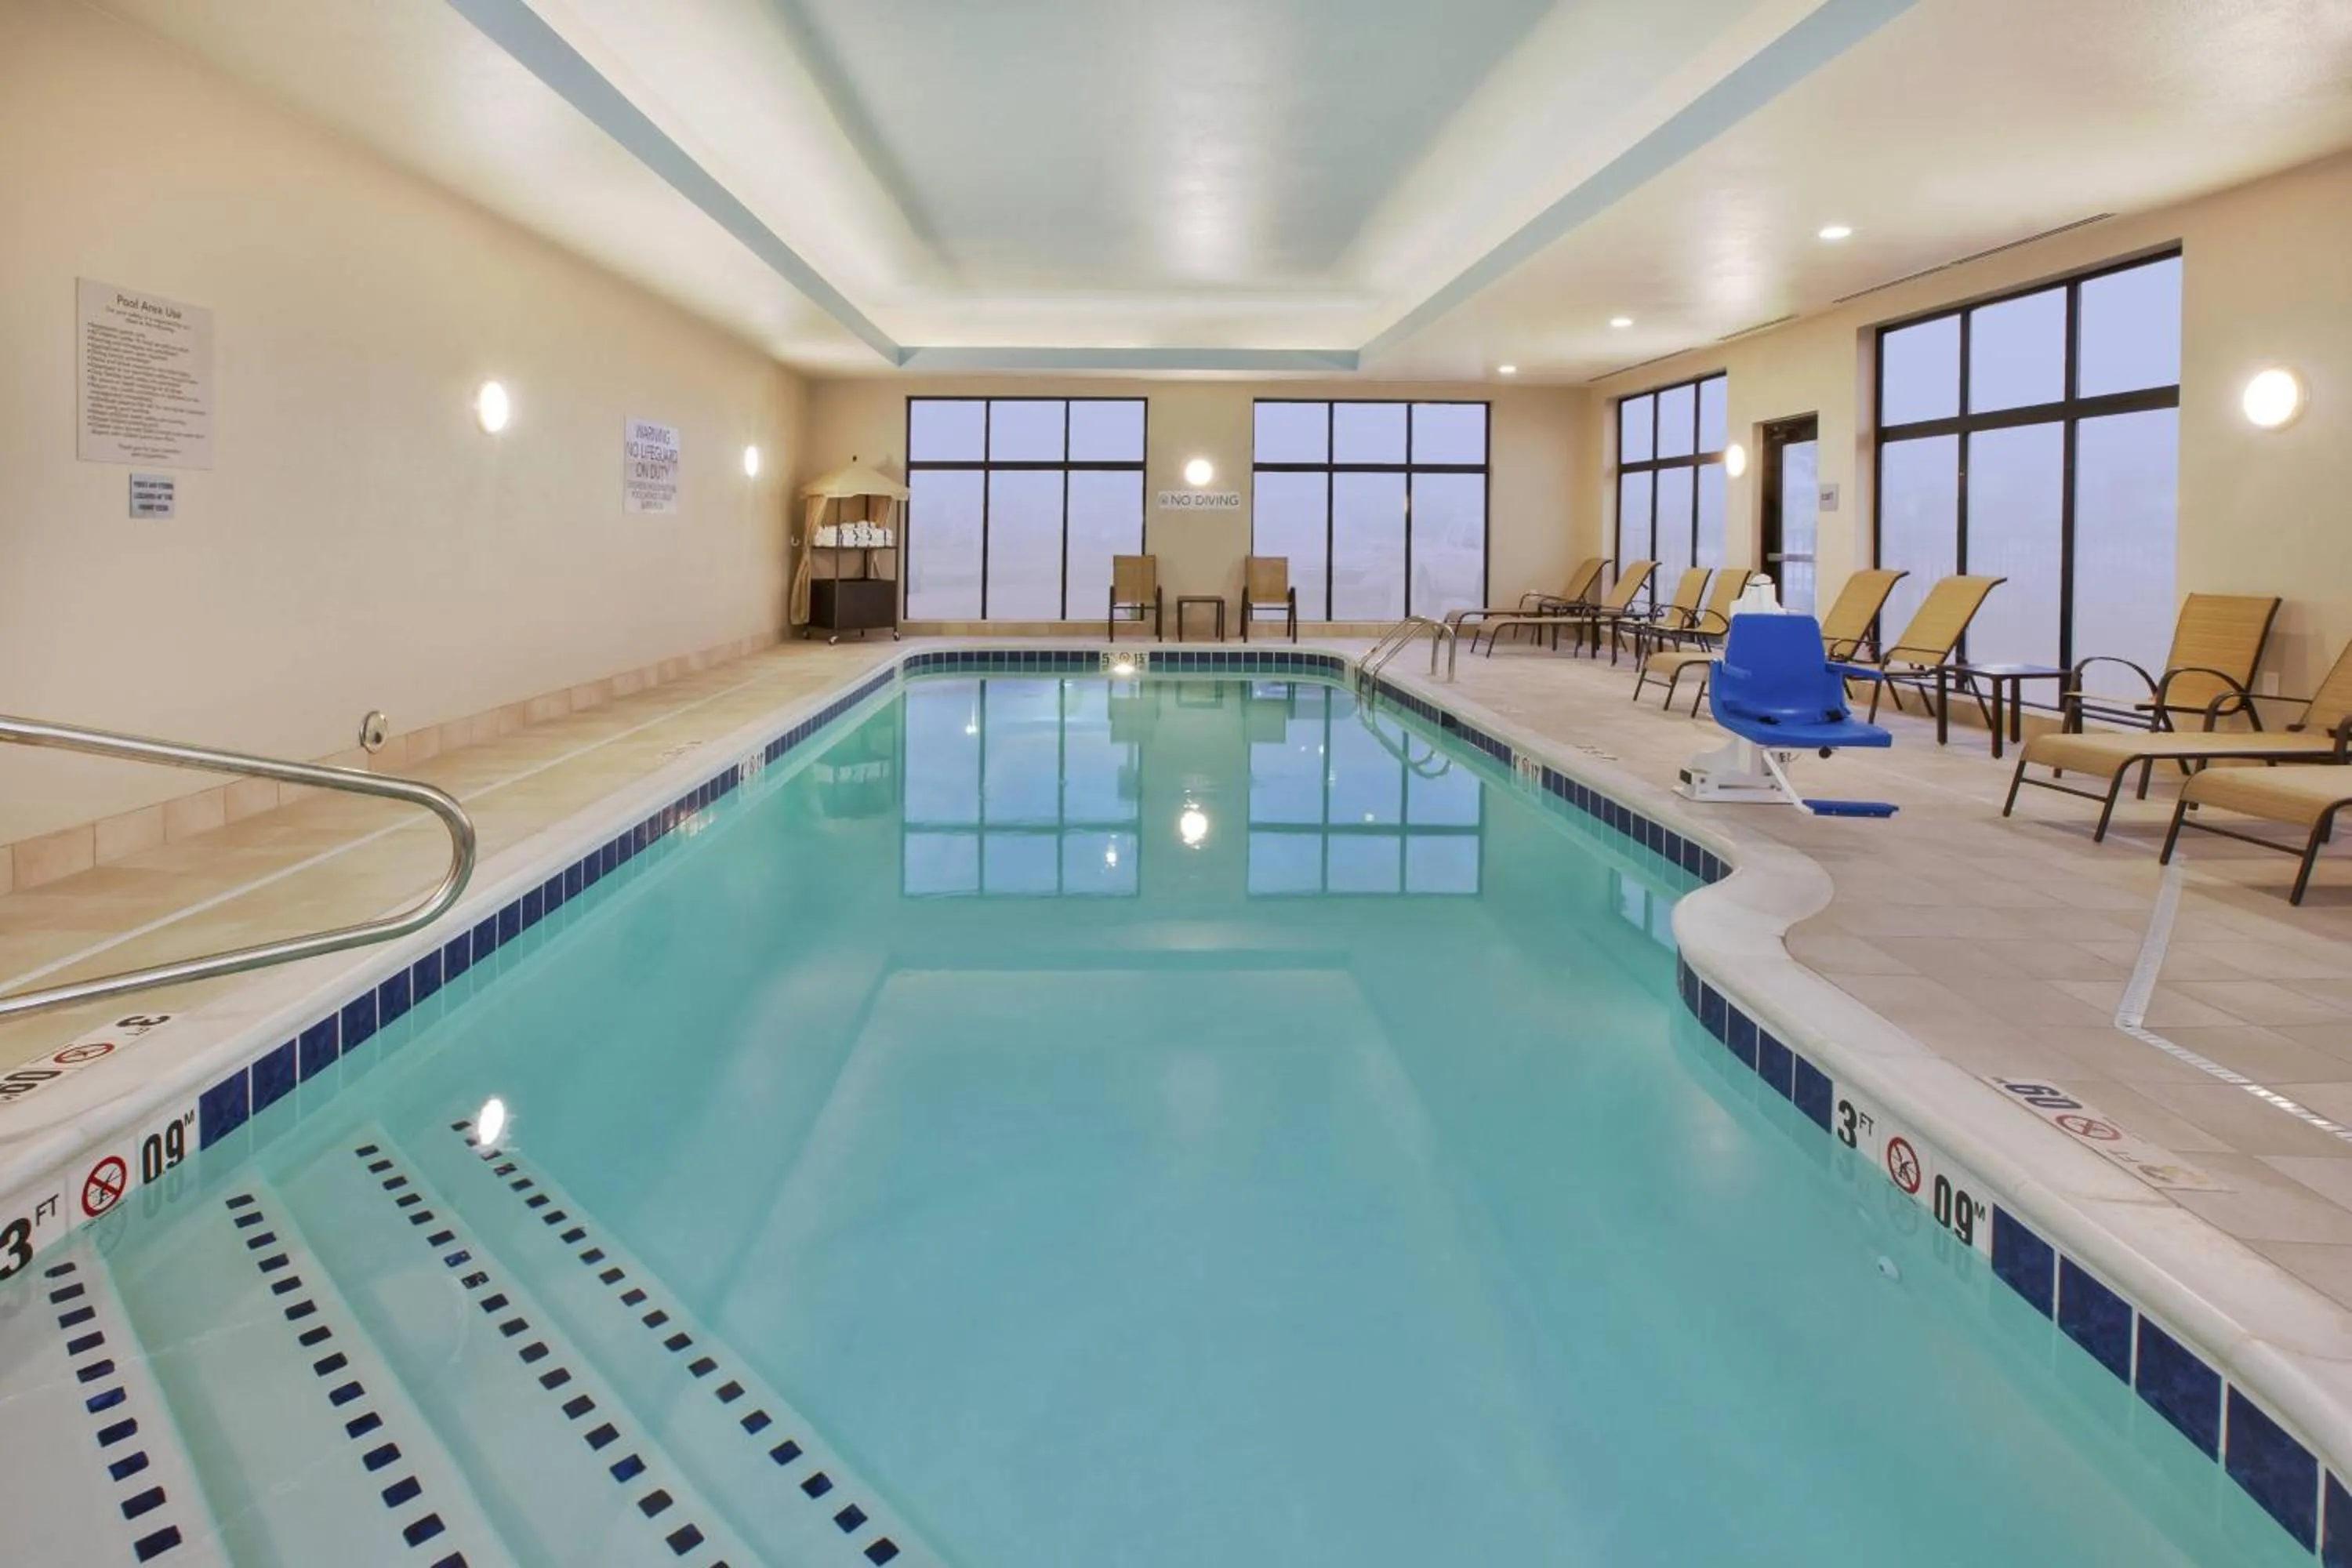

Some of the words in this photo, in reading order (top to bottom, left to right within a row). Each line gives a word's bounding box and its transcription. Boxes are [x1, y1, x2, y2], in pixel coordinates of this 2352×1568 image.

[117, 293, 139, 310] Pool
[1170, 494, 1192, 506] NO
[1195, 495, 1240, 506] DIVING
[183, 1109, 195, 1127] M
[1837, 1099, 1857, 1149] 3
[1859, 1112, 1875, 1137] FT
[1974, 1200, 1986, 1223] M
[0, 1218, 34, 1281] 3
[36, 1193, 60, 1227] FT
